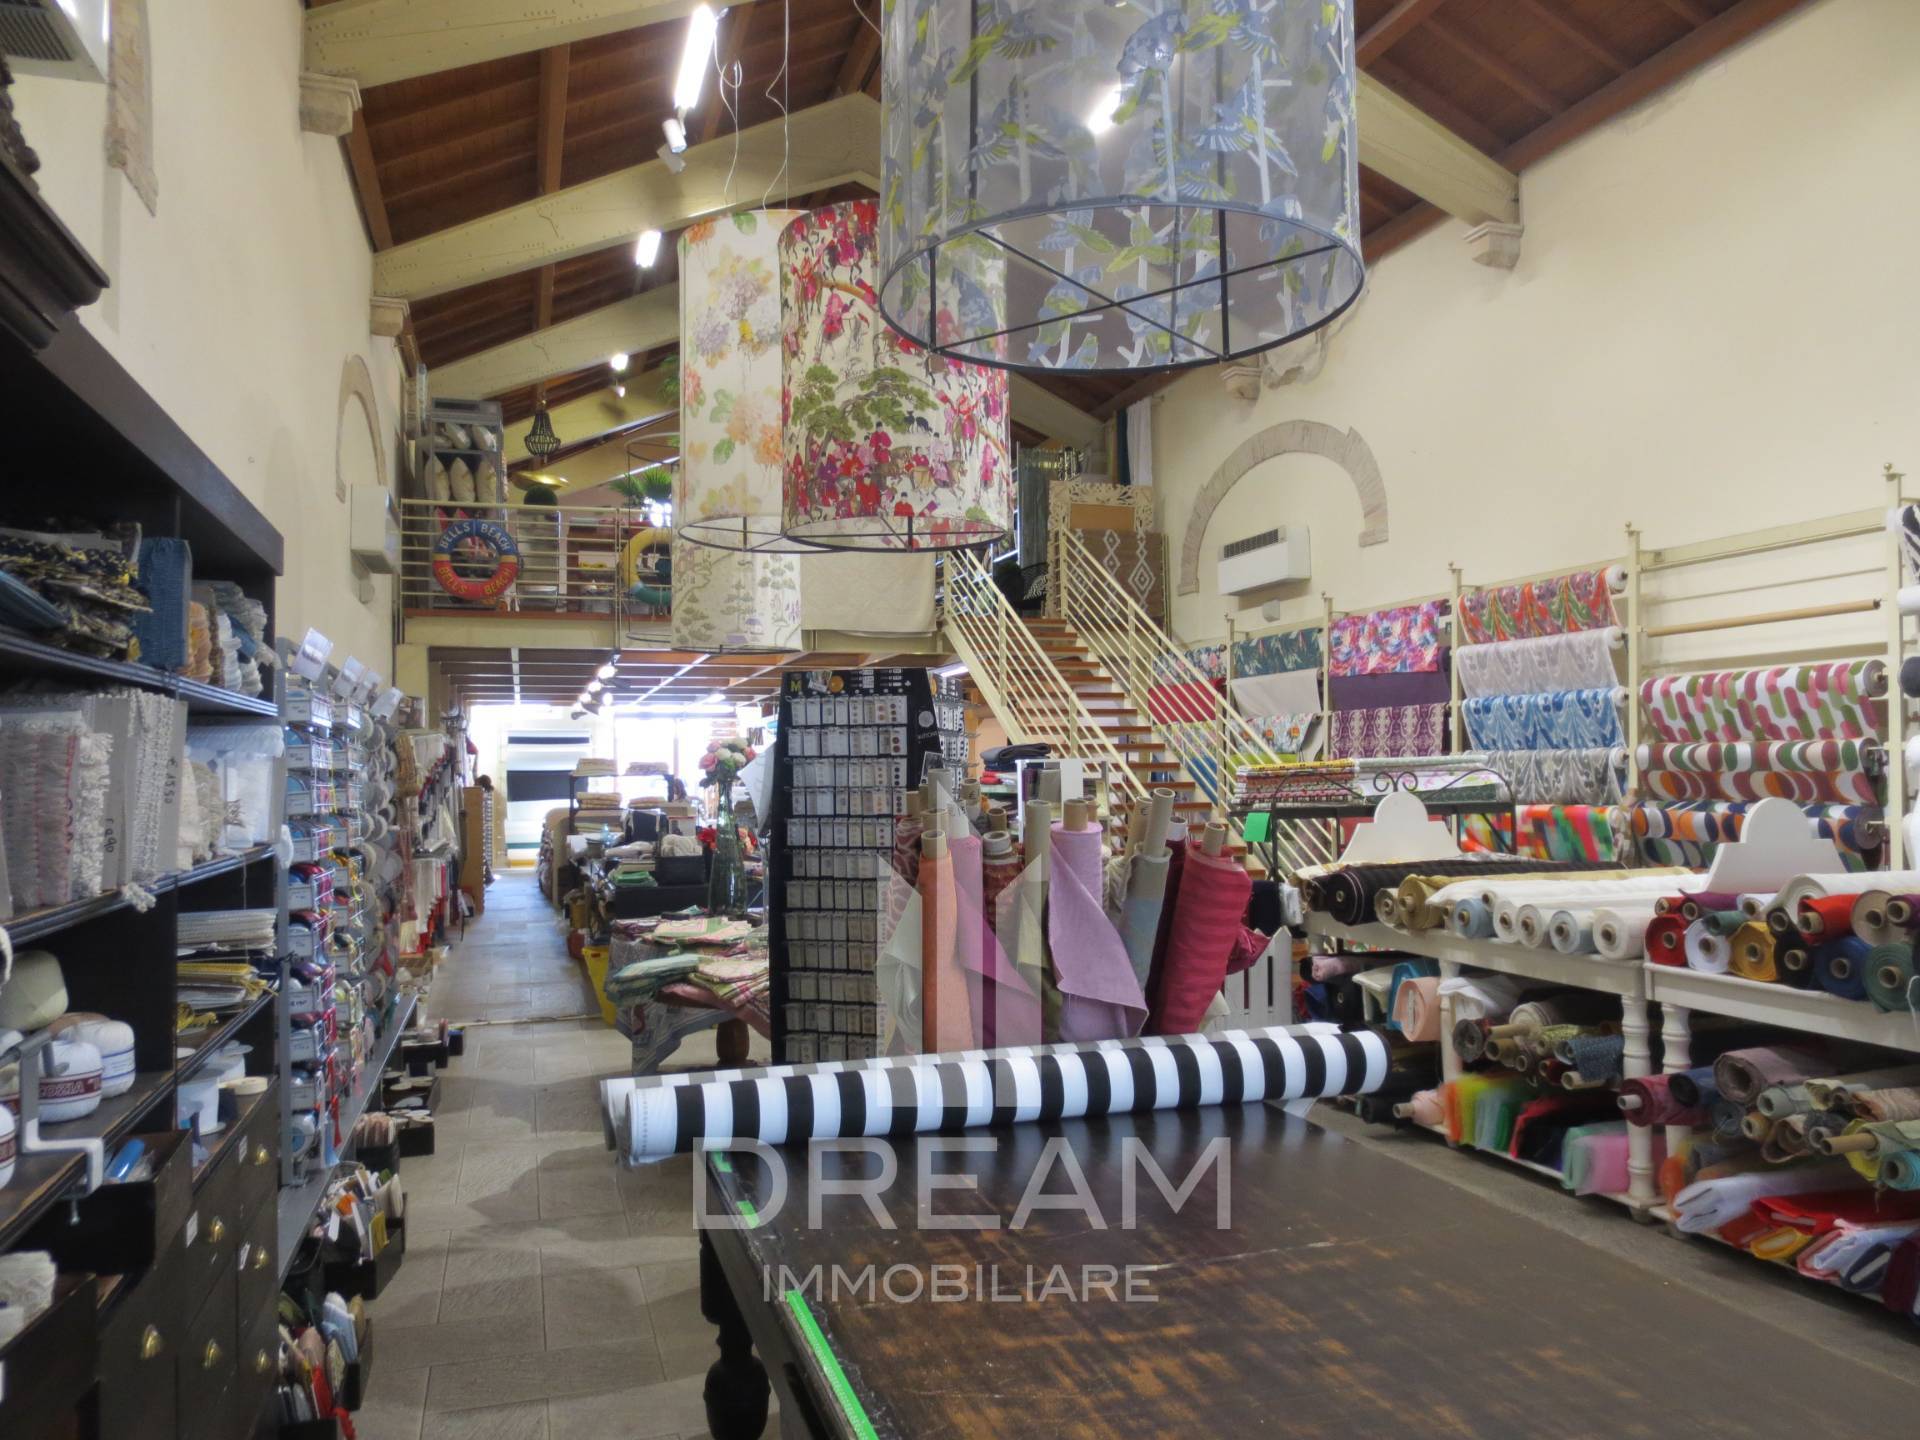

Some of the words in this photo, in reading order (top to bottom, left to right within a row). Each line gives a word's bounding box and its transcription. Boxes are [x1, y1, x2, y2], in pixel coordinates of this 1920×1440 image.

[440, 522, 470, 549] BELLS
[480, 523, 511, 551] BEACH
[438, 567, 468, 594] BELLS
[484, 568, 514, 594] BEACH
